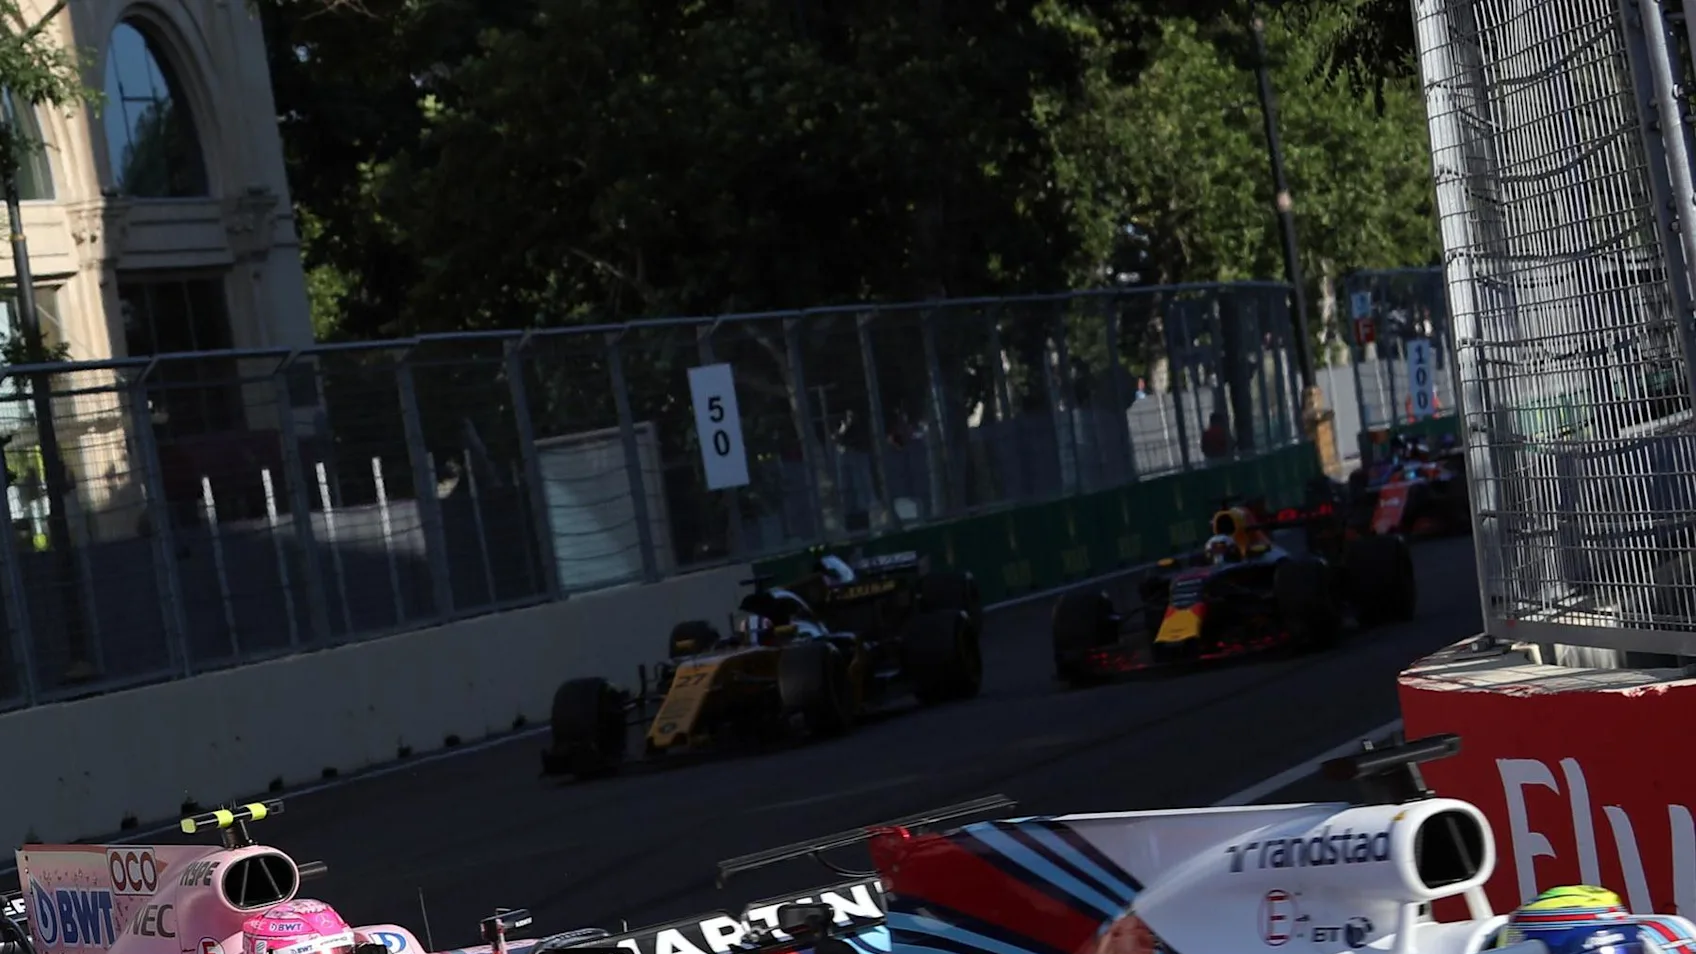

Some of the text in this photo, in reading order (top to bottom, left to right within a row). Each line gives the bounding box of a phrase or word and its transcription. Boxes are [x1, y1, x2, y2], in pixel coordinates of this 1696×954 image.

[1257, 826, 1392, 869] randstad
[110, 851, 157, 892] OCO
[55, 889, 116, 945] BWT
[127, 904, 176, 938] NEC
[1313, 927, 1341, 942] BT
